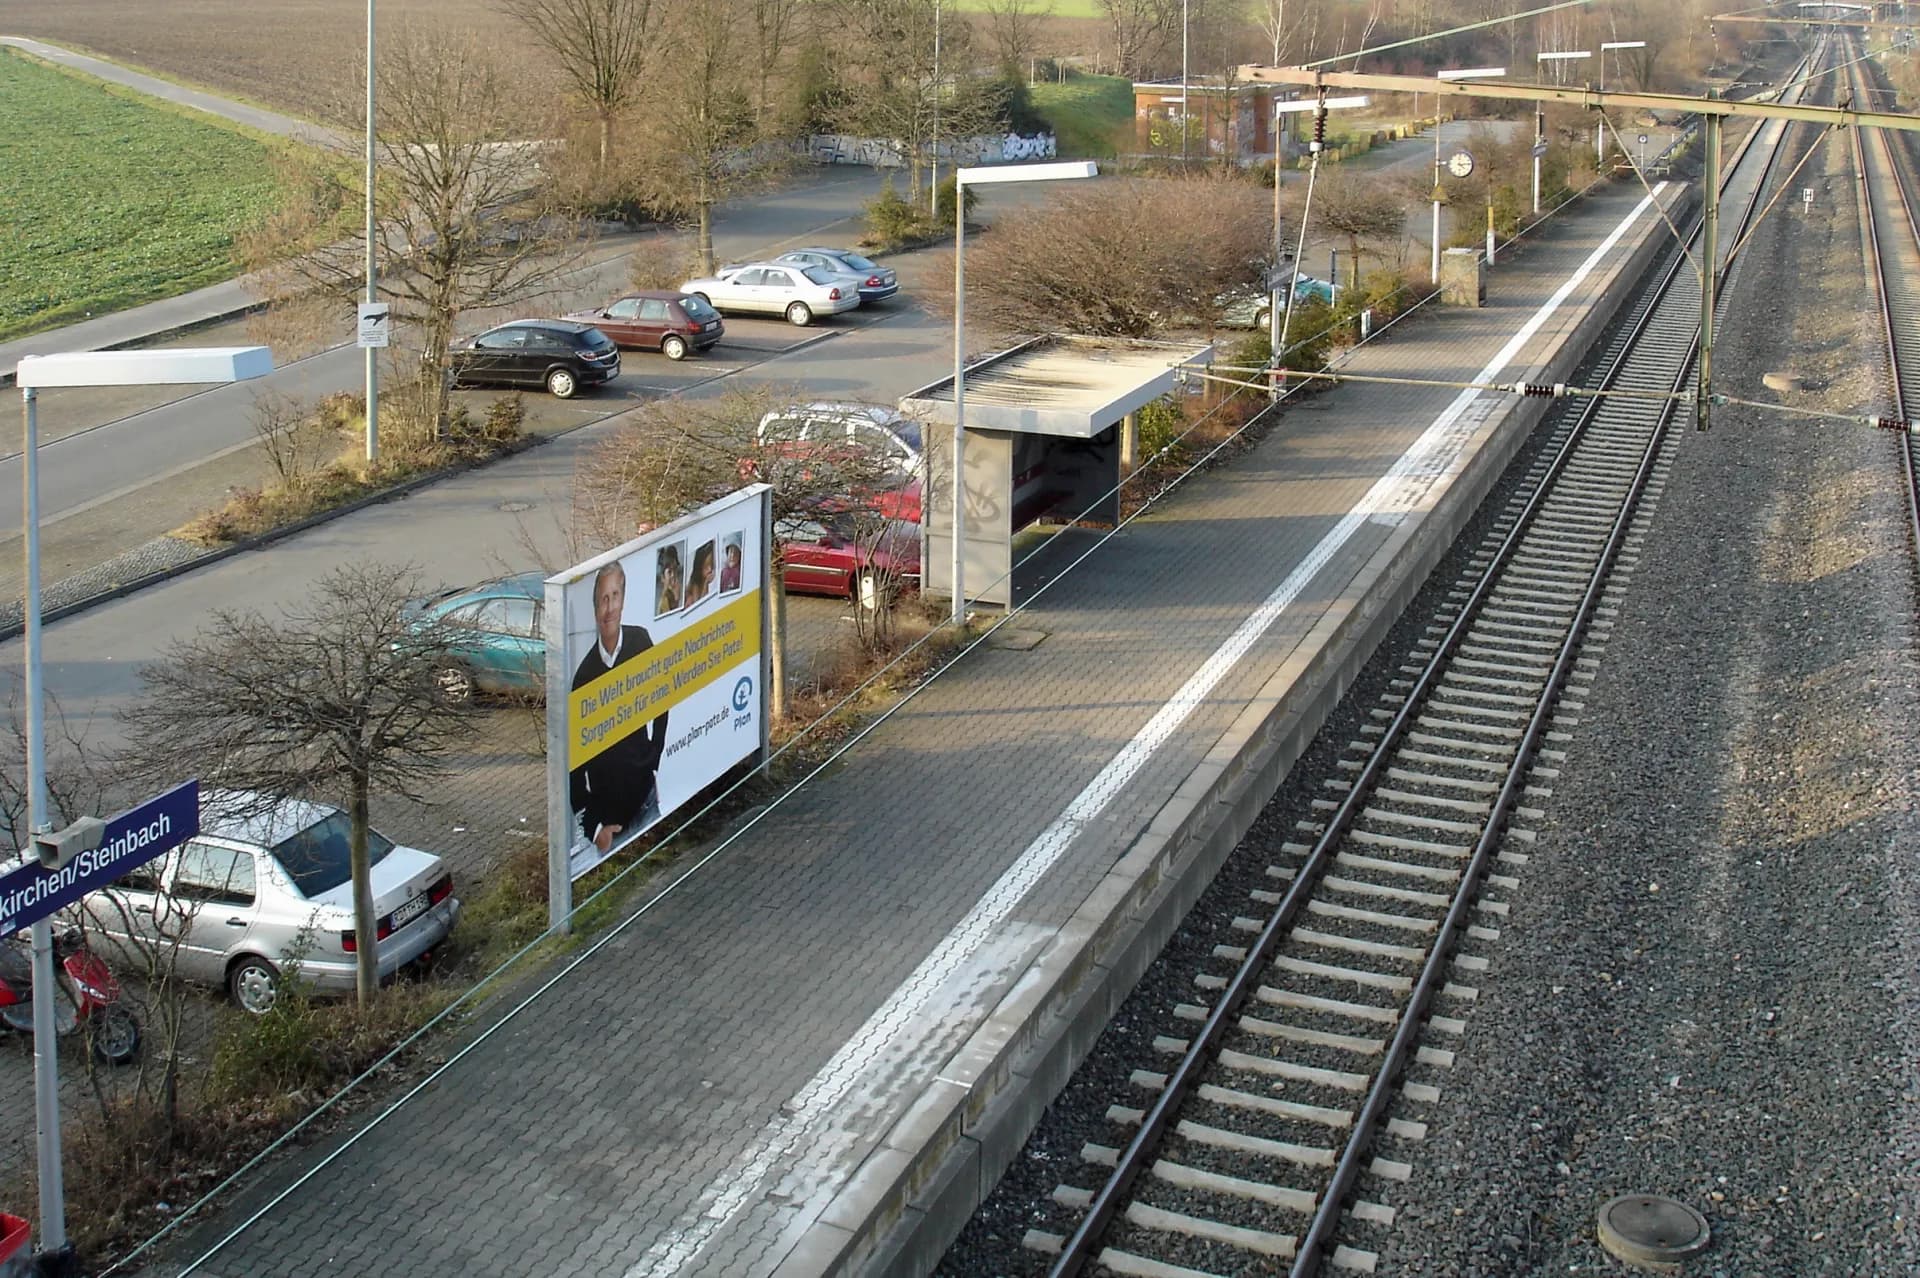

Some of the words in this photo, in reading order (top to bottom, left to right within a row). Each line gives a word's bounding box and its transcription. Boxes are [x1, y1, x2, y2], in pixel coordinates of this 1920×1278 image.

[1804, 190, 1812, 200] H
[581, 696, 596, 719] Die
[600, 680, 624, 707] Welt
[626, 658, 661, 692] braucht
[663, 649, 683, 675] gute
[581, 716, 615, 746] Sorgen
[616, 704, 632, 724] Sie
[635, 694, 649, 714] für
[672, 661, 707, 691] Werden
[708, 650, 721, 669] Sie
[723, 632, 743, 660] Pate!
[665, 705, 729, 757] www.plan-pate.de
[734, 712, 751, 731] Plan
